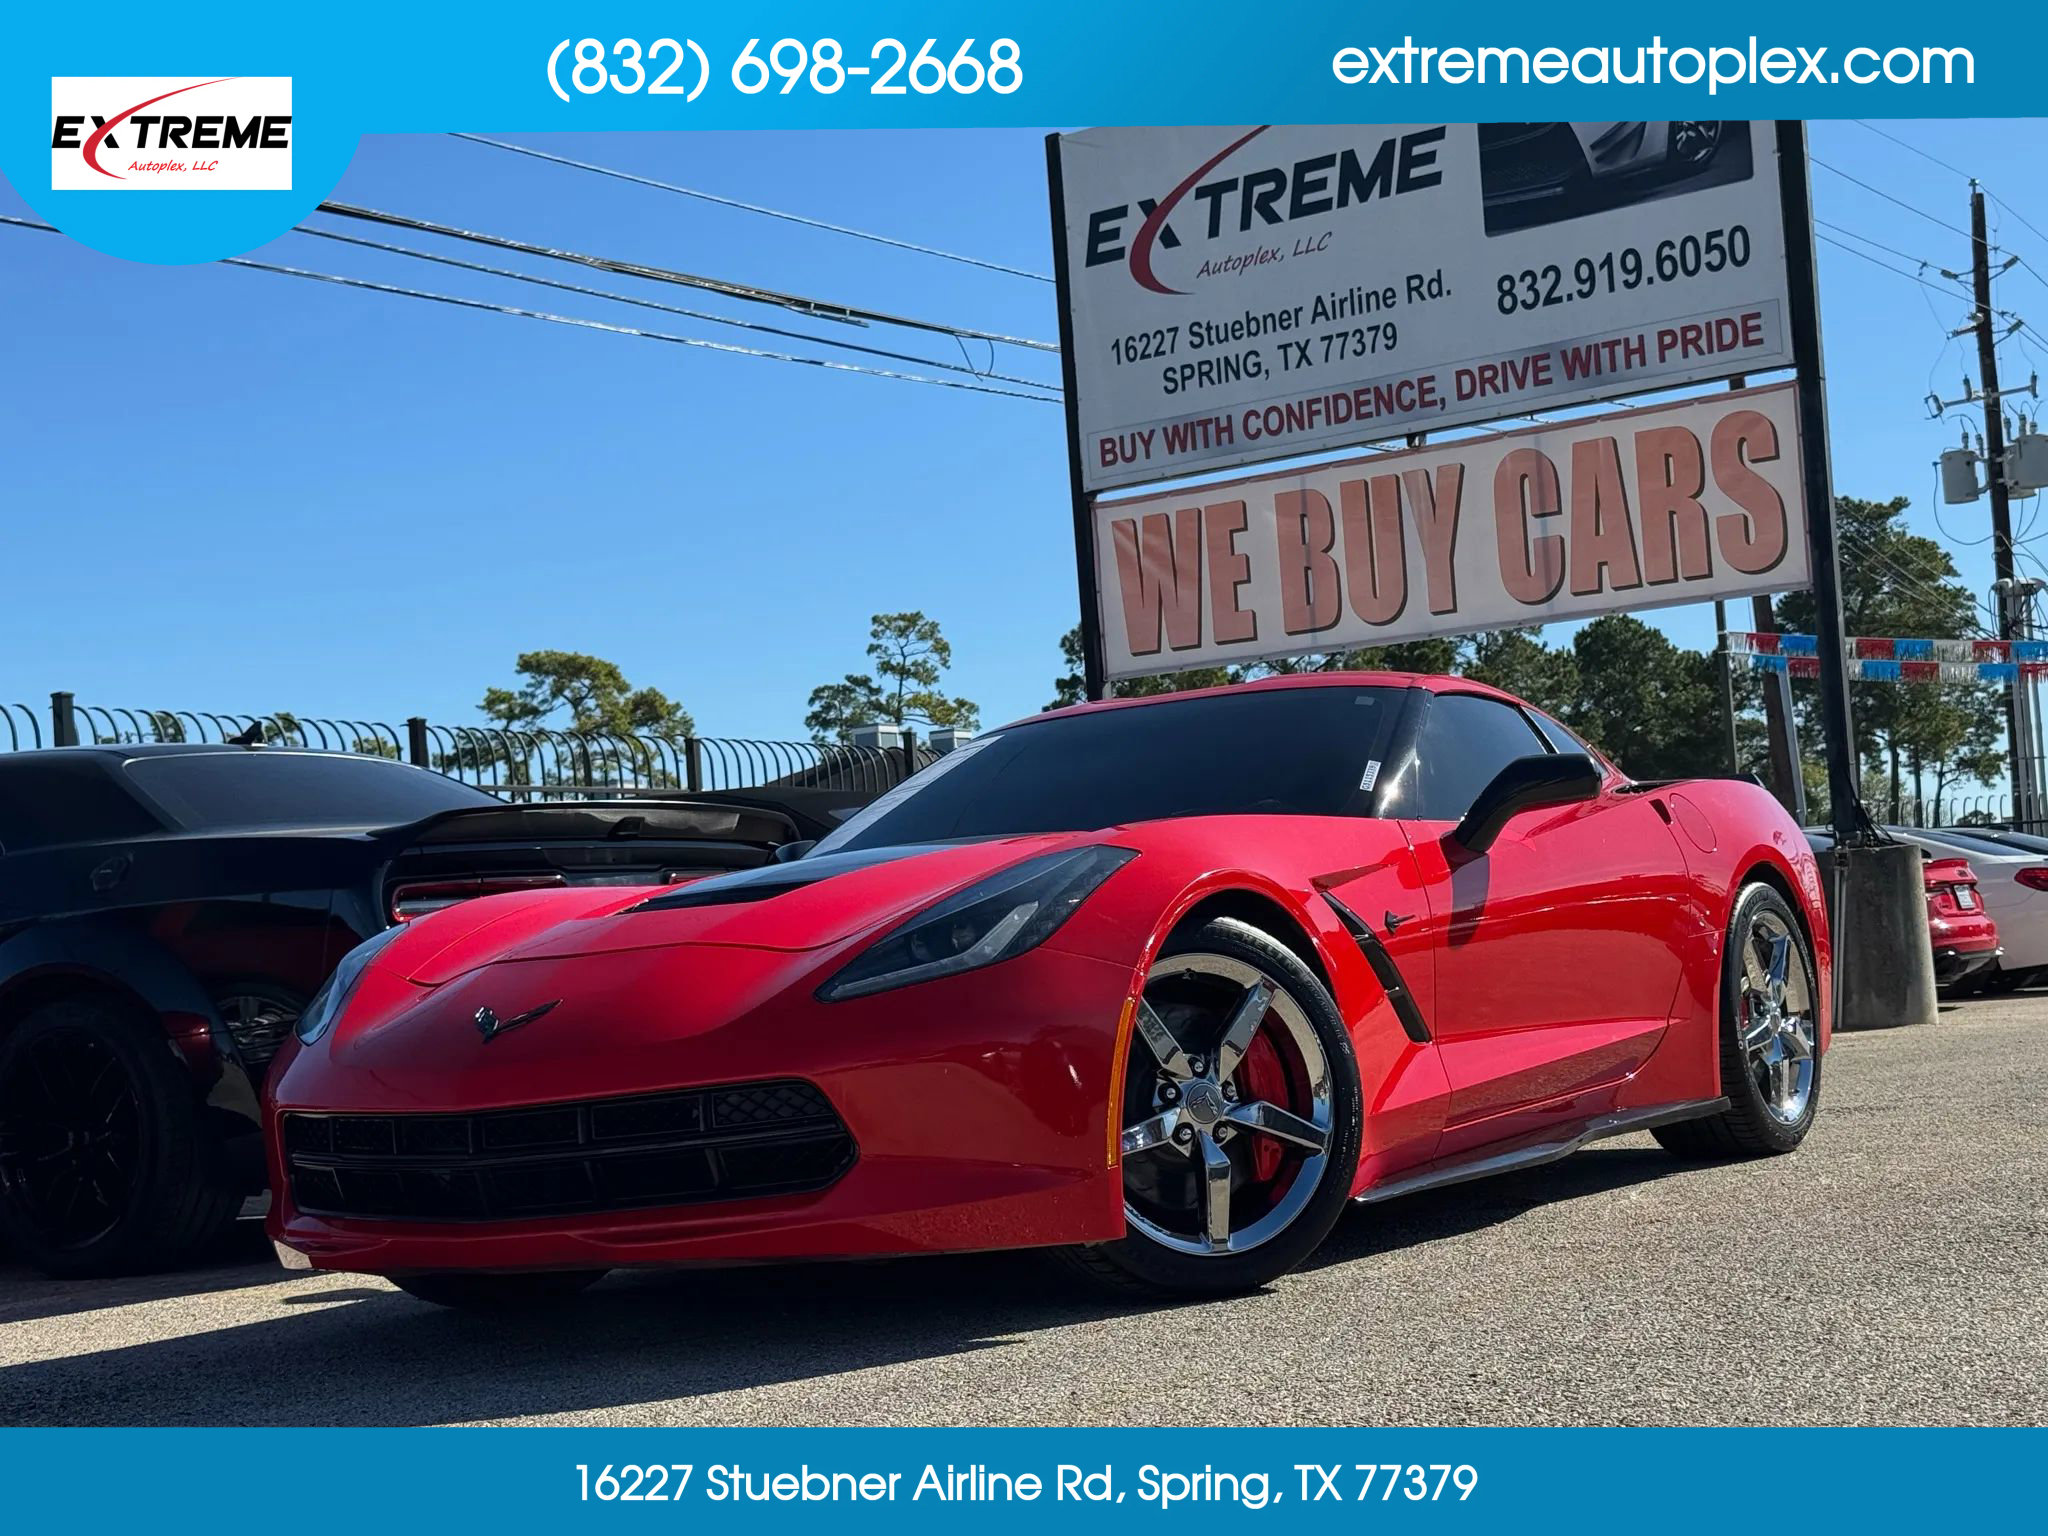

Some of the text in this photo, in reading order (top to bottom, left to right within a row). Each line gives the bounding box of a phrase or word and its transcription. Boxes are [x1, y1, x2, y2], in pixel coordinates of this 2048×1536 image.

[1085, 125, 1447, 268] EXTREME
[1196, 231, 1333, 279] Autoplex, LLC
[1497, 225, 1751, 315] 832.919.6050
[1110, 269, 1452, 366] 16227 Stuebner Airline Rd.
[1162, 322, 1398, 396] SPRING, TX 77379
[1099, 311, 1765, 468] BUY WITH CONFIDENCE, DRIVE WITH PRIDE
[1110, 409, 1788, 657] WE BUY CARS
